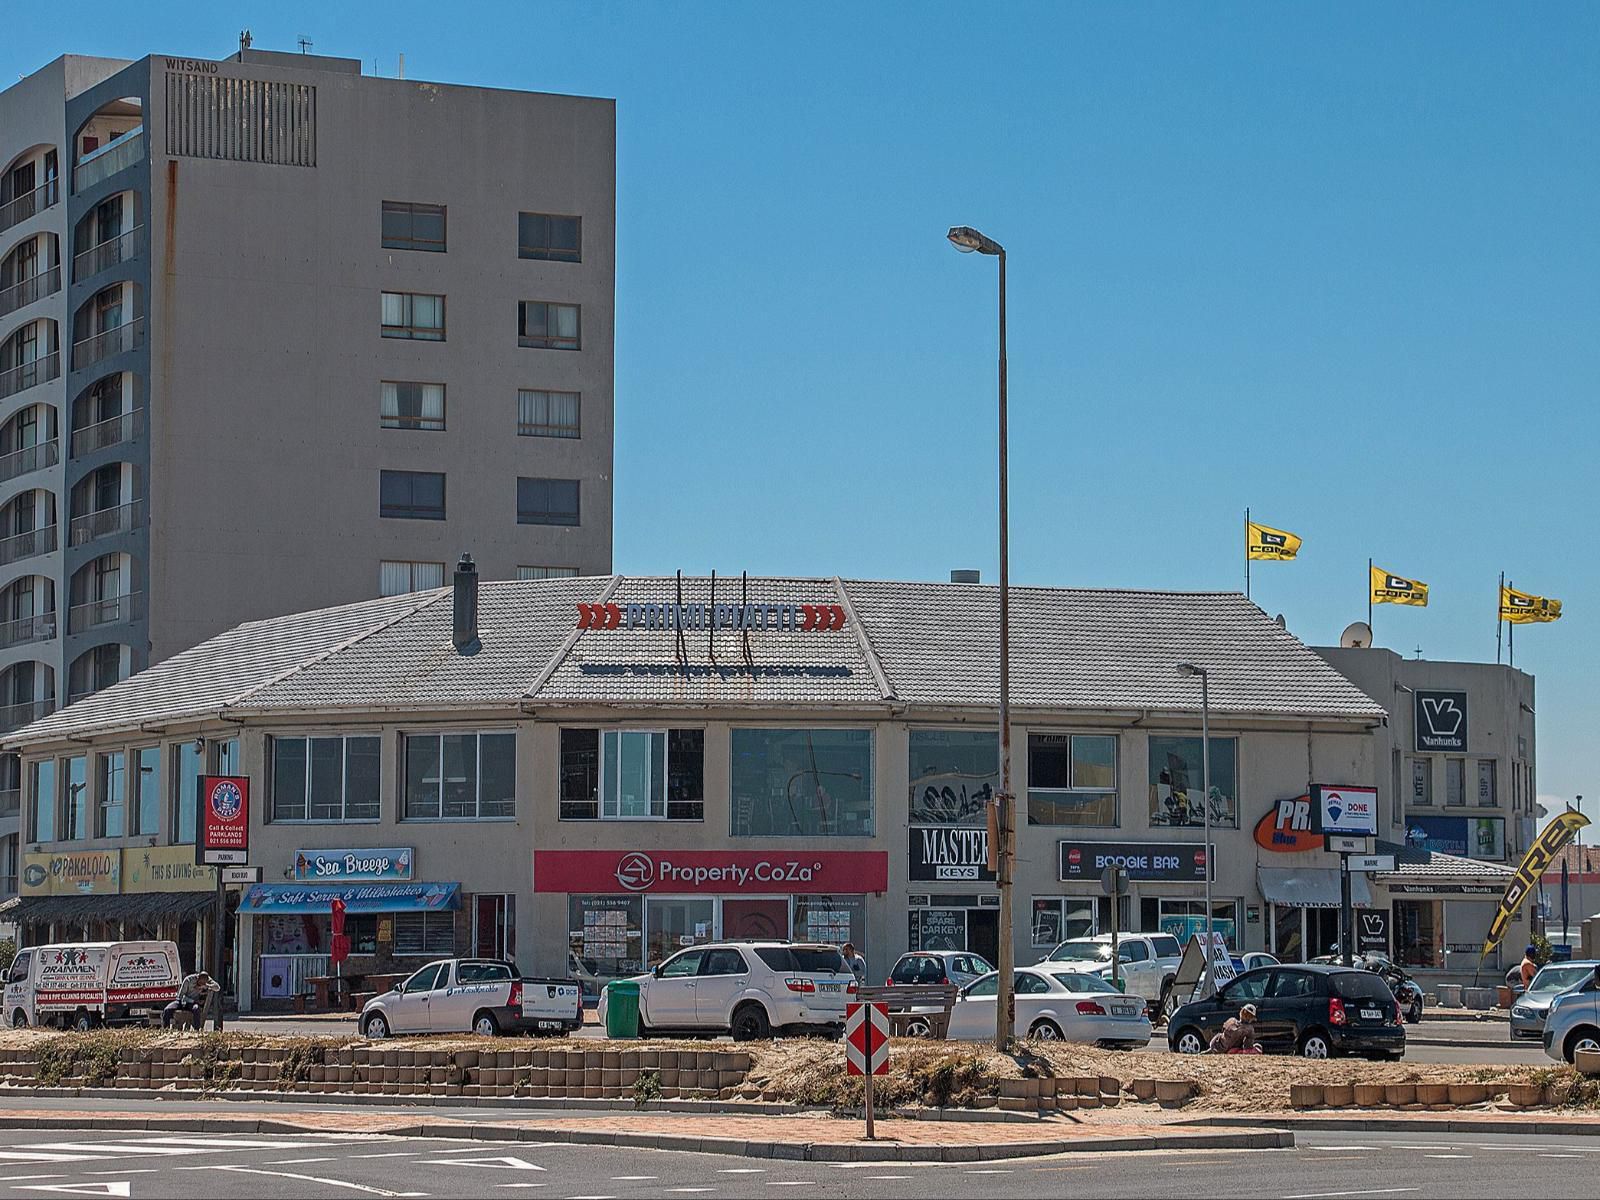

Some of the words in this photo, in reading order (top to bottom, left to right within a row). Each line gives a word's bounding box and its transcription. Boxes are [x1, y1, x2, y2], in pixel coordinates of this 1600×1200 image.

[165, 58, 218, 74] WITSAND
[627, 604, 705, 631] PRIMI
[714, 604, 796, 632] PIATTI
[1422, 736, 1462, 746] Vanhunks
[214, 783, 240, 800] ROMAN'S
[1415, 776, 1424, 796] KITE
[1480, 778, 1489, 797] SUP
[217, 807, 237, 816] PIZZA
[1347, 803, 1368, 812] DONE
[1272, 832, 1297, 846] Blue
[62, 855, 111, 879] PAKALOLO
[315, 855, 341, 876] Sea
[343, 854, 390, 876] Breeze
[1095, 855, 1148, 869] BOOGIE
[1153, 856, 1180, 869] BAR
[152, 866, 164, 880] THIS
[165, 865, 171, 880] IS
[172, 864, 192, 879] LIVING
[940, 868, 975, 877] KEYS
[279, 893, 305, 905] Soft
[307, 890, 341, 903] Serve
[343, 889, 354, 900] &
[356, 885, 422, 900] Milkshakes
[1404, 885, 1434, 893] Vanhunks
[1462, 885, 1492, 893] Vanhunks
[926, 917, 956, 925] SPARE
[922, 926, 941, 934] CAR
[941, 926, 964, 934] KEY?
[43, 965, 96, 973] DRAINMEN
